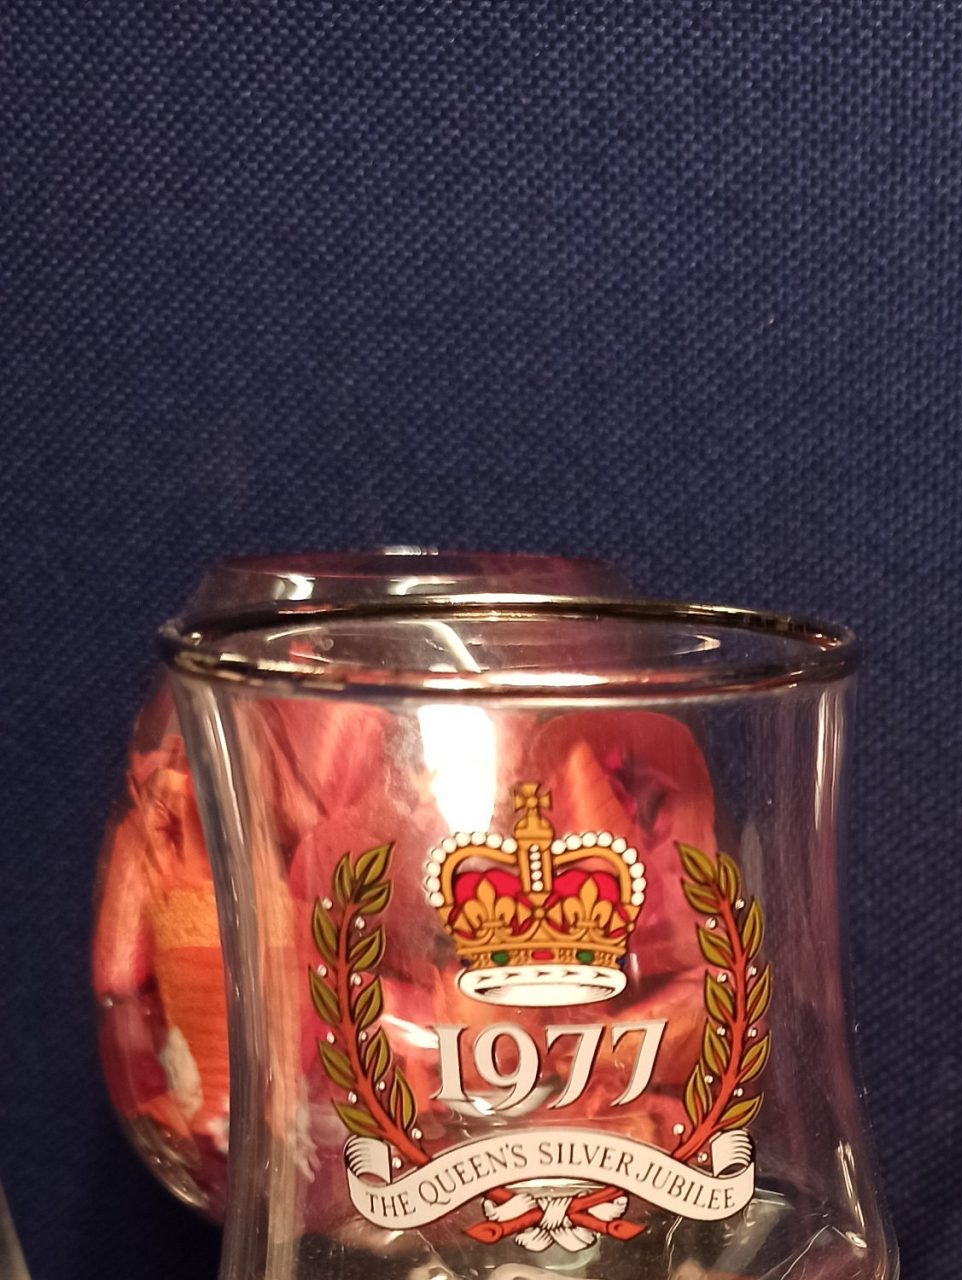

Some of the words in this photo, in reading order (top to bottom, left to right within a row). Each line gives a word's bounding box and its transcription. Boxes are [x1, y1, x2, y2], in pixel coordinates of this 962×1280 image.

[430, 1022, 669, 1112] 1977
[365, 1190, 417, 1218] THE
[417, 1142, 529, 1207] QUEEN'S
[538, 1141, 632, 1177] SILVER
[634, 1161, 736, 1211] JUBILEE
